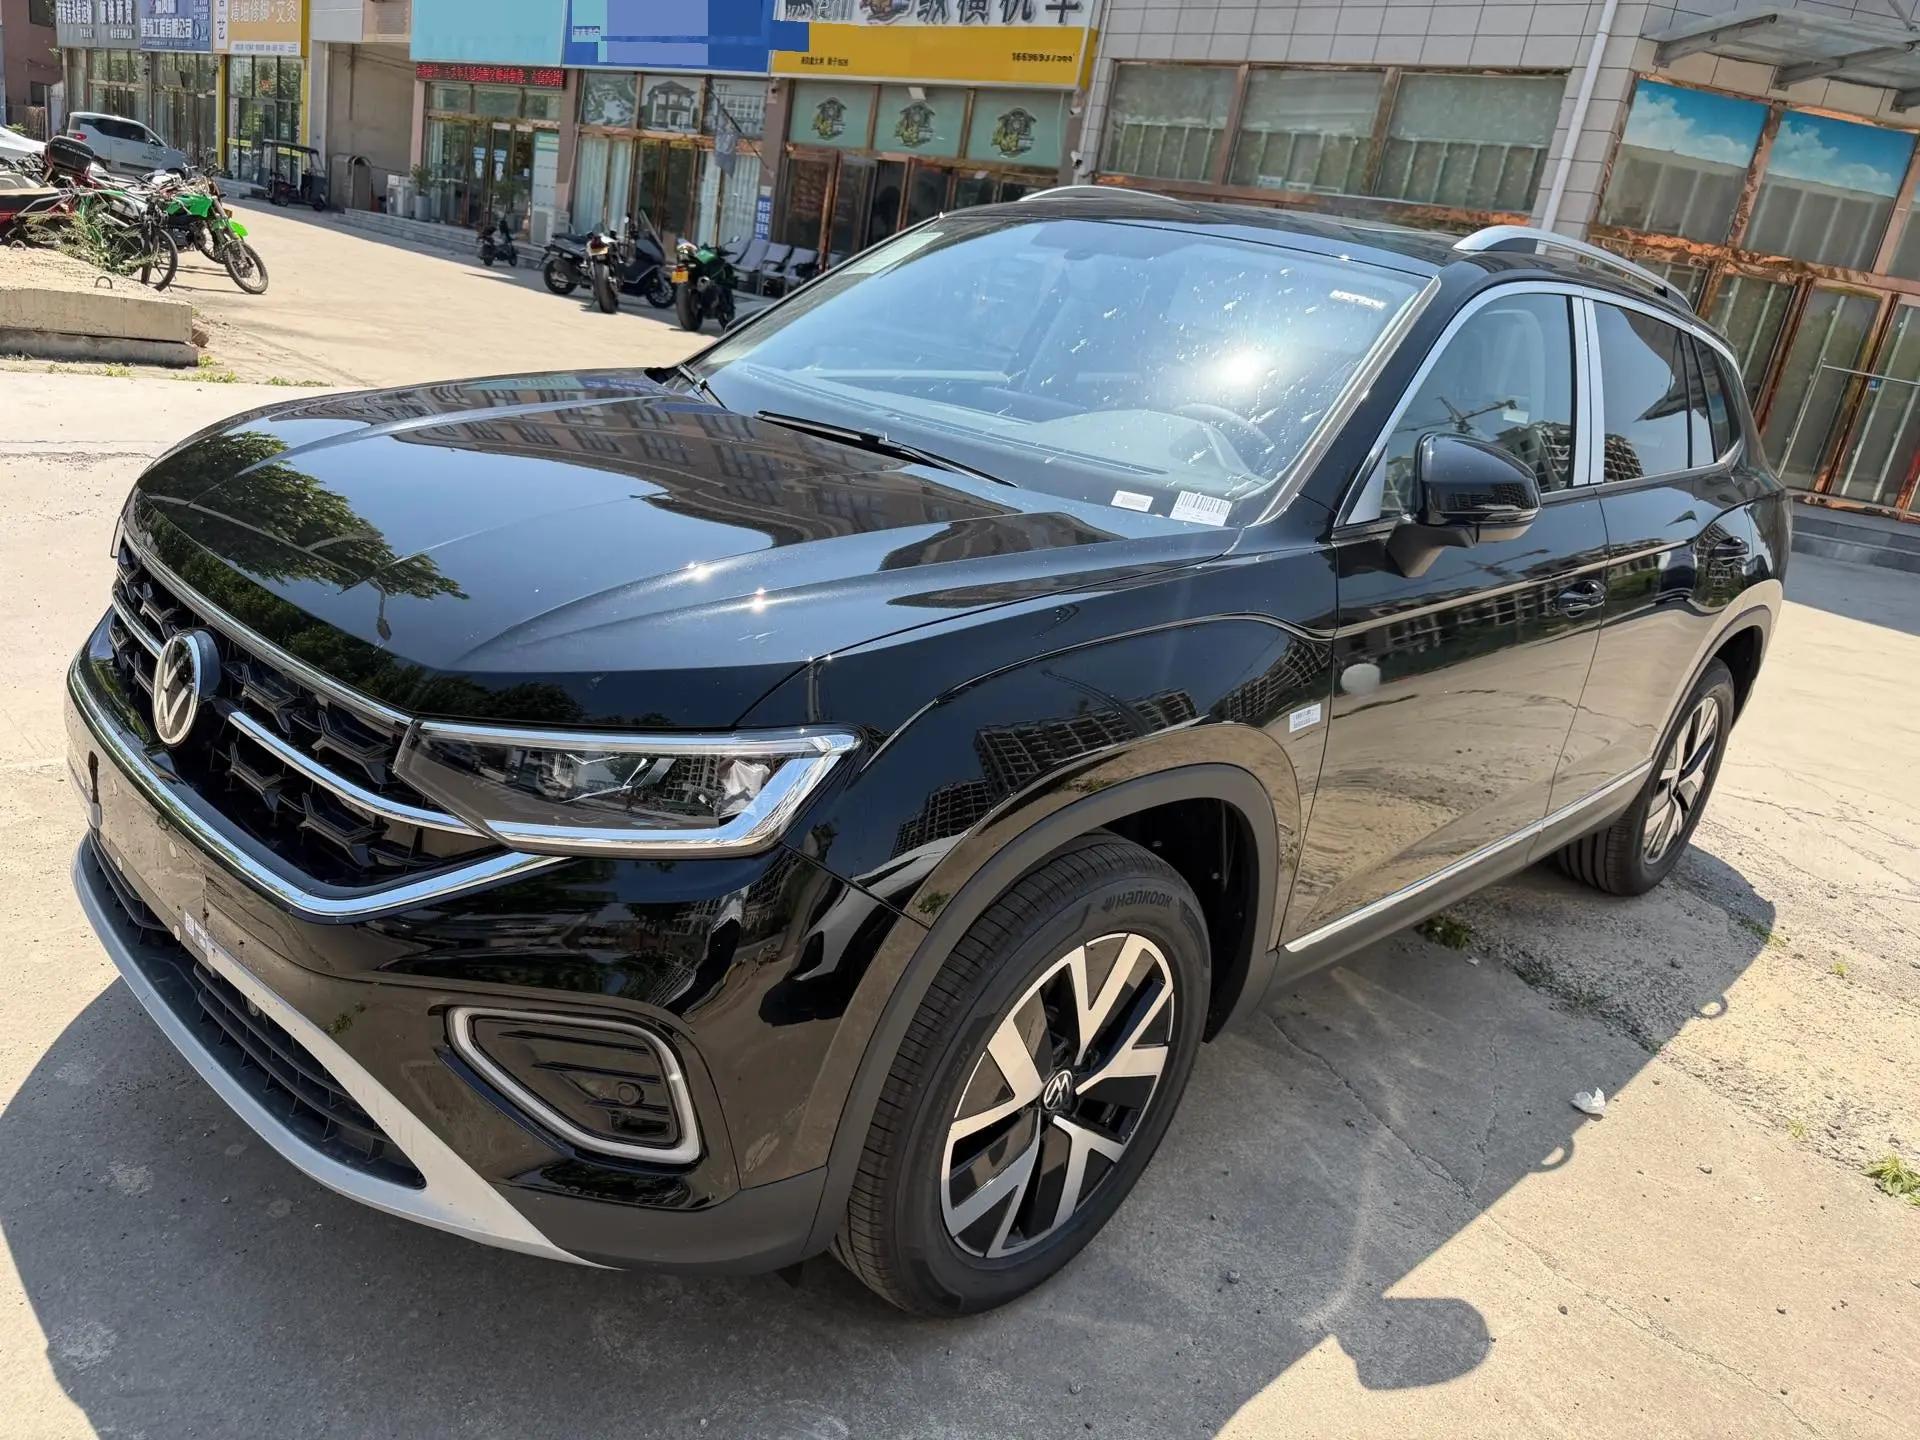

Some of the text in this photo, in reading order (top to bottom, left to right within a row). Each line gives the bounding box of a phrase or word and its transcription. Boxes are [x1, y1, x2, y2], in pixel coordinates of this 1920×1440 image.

[141, 18, 193, 38] 建筑工程有限公司
